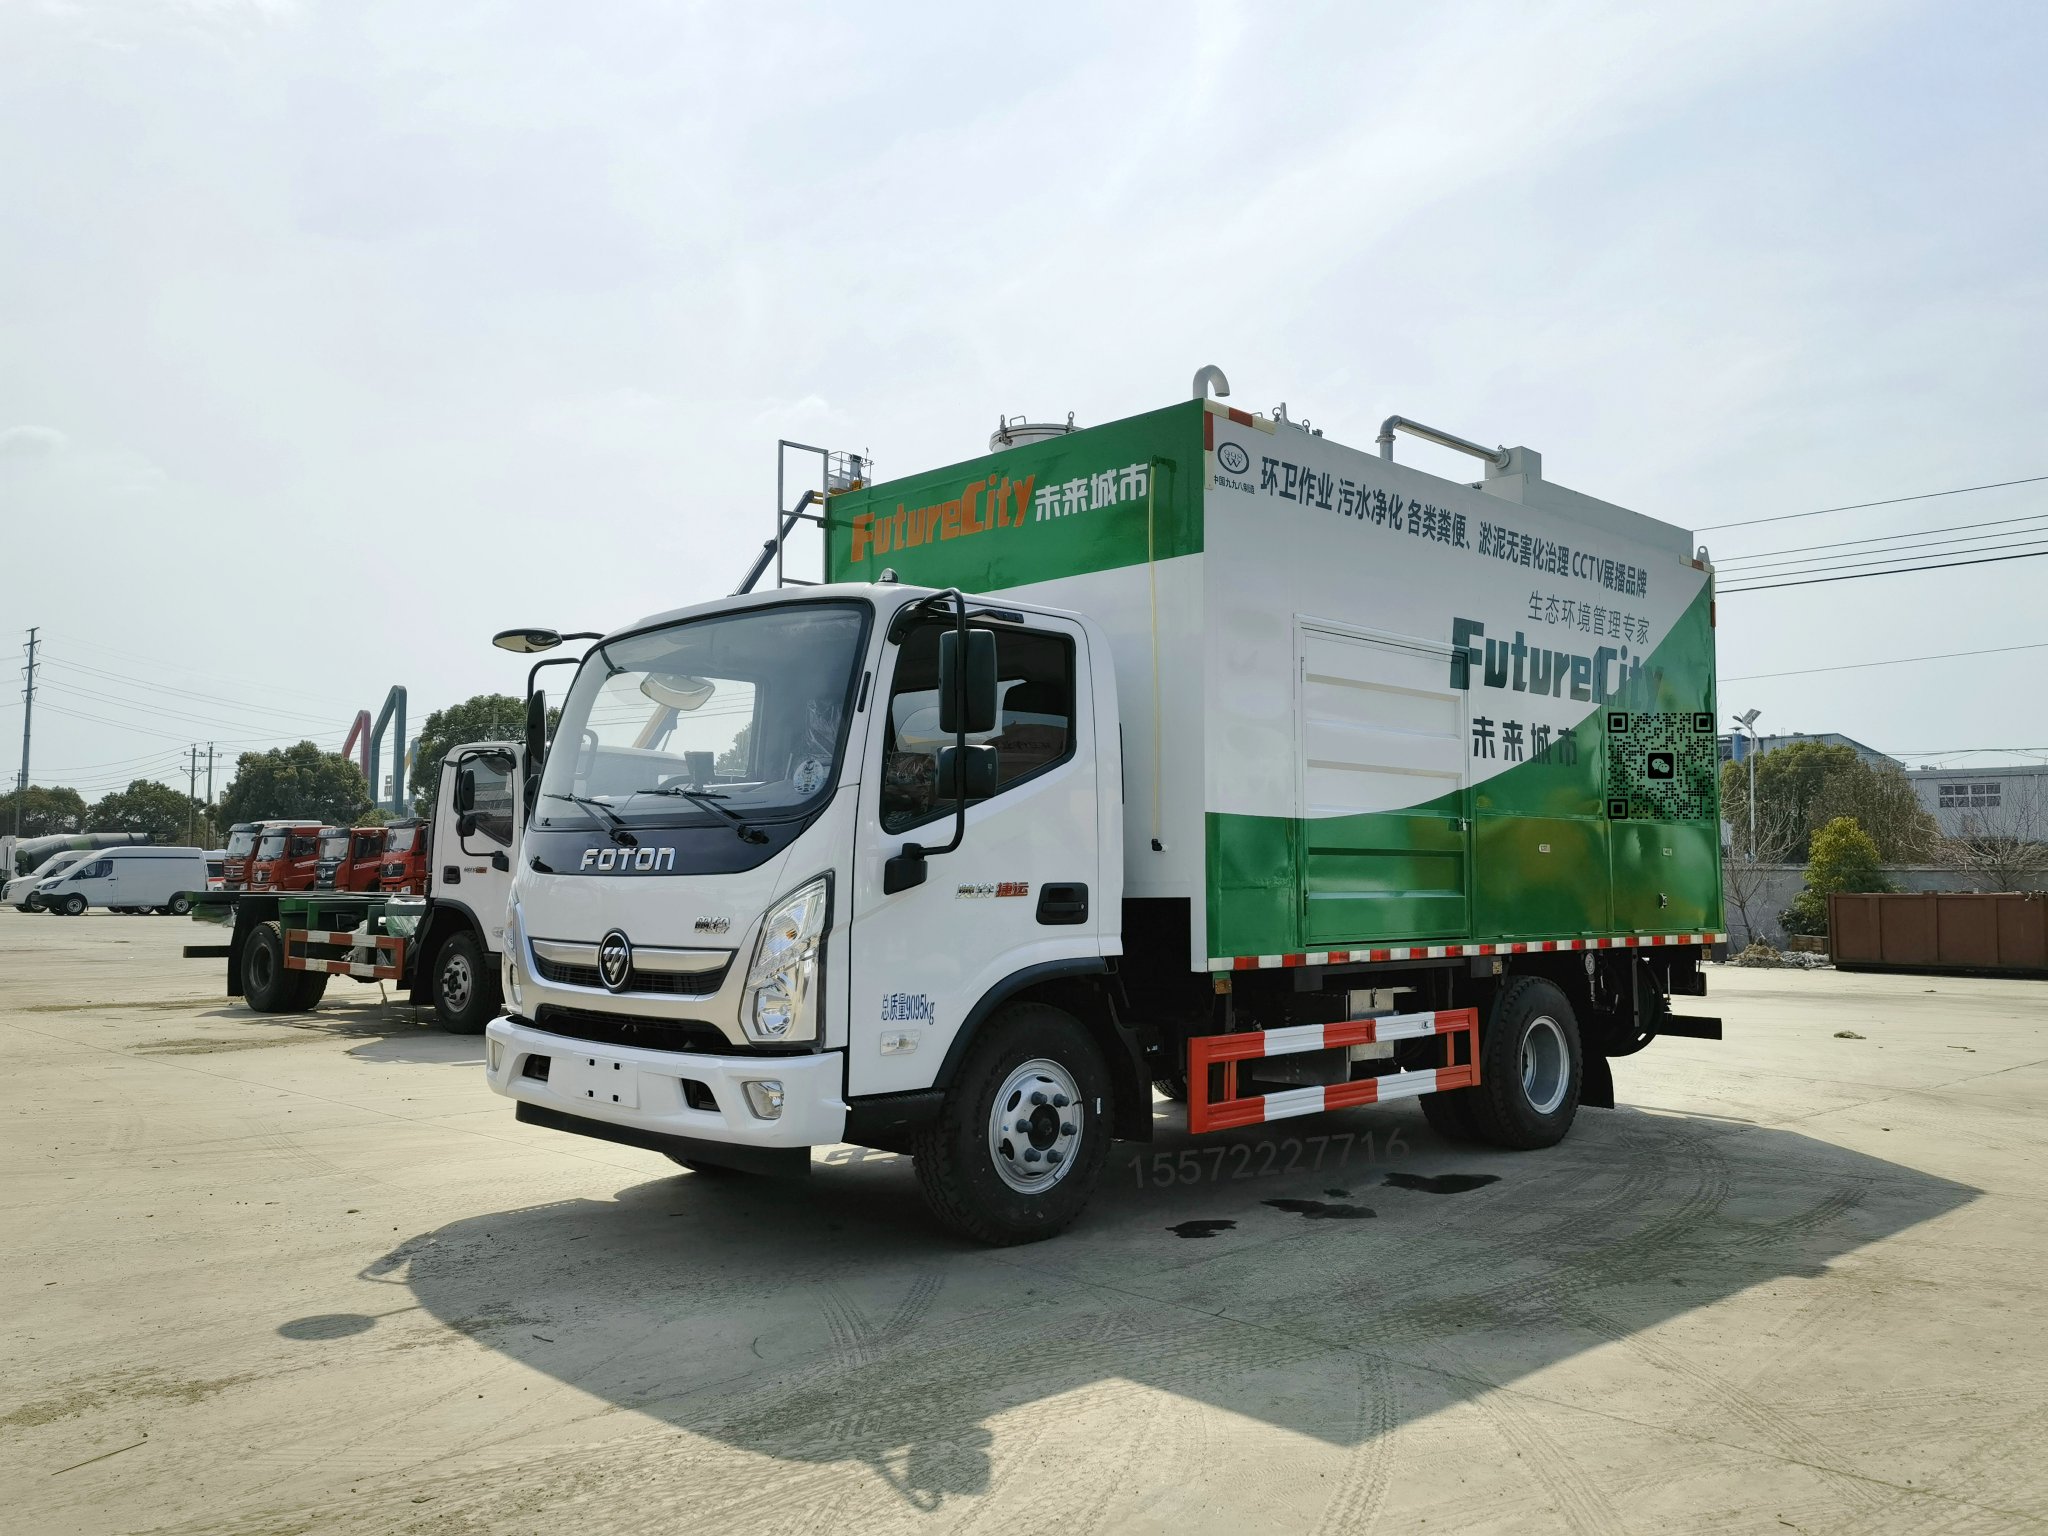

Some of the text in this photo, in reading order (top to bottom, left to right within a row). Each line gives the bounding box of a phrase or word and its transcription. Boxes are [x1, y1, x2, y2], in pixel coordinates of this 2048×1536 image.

[850, 463, 1149, 563] FutureCity 未来城市
[1260, 456, 1334, 511] 环卫作业
[1337, 478, 1404, 531] 污水净化
[1572, 551, 1648, 599] CCTV展播品牌
[1527, 590, 1650, 645] 生态环境管理专家
[1449, 617, 1665, 714] FutureCity
[1472, 716, 1578, 768] 未来城市
[579, 847, 677, 872] FOTON
